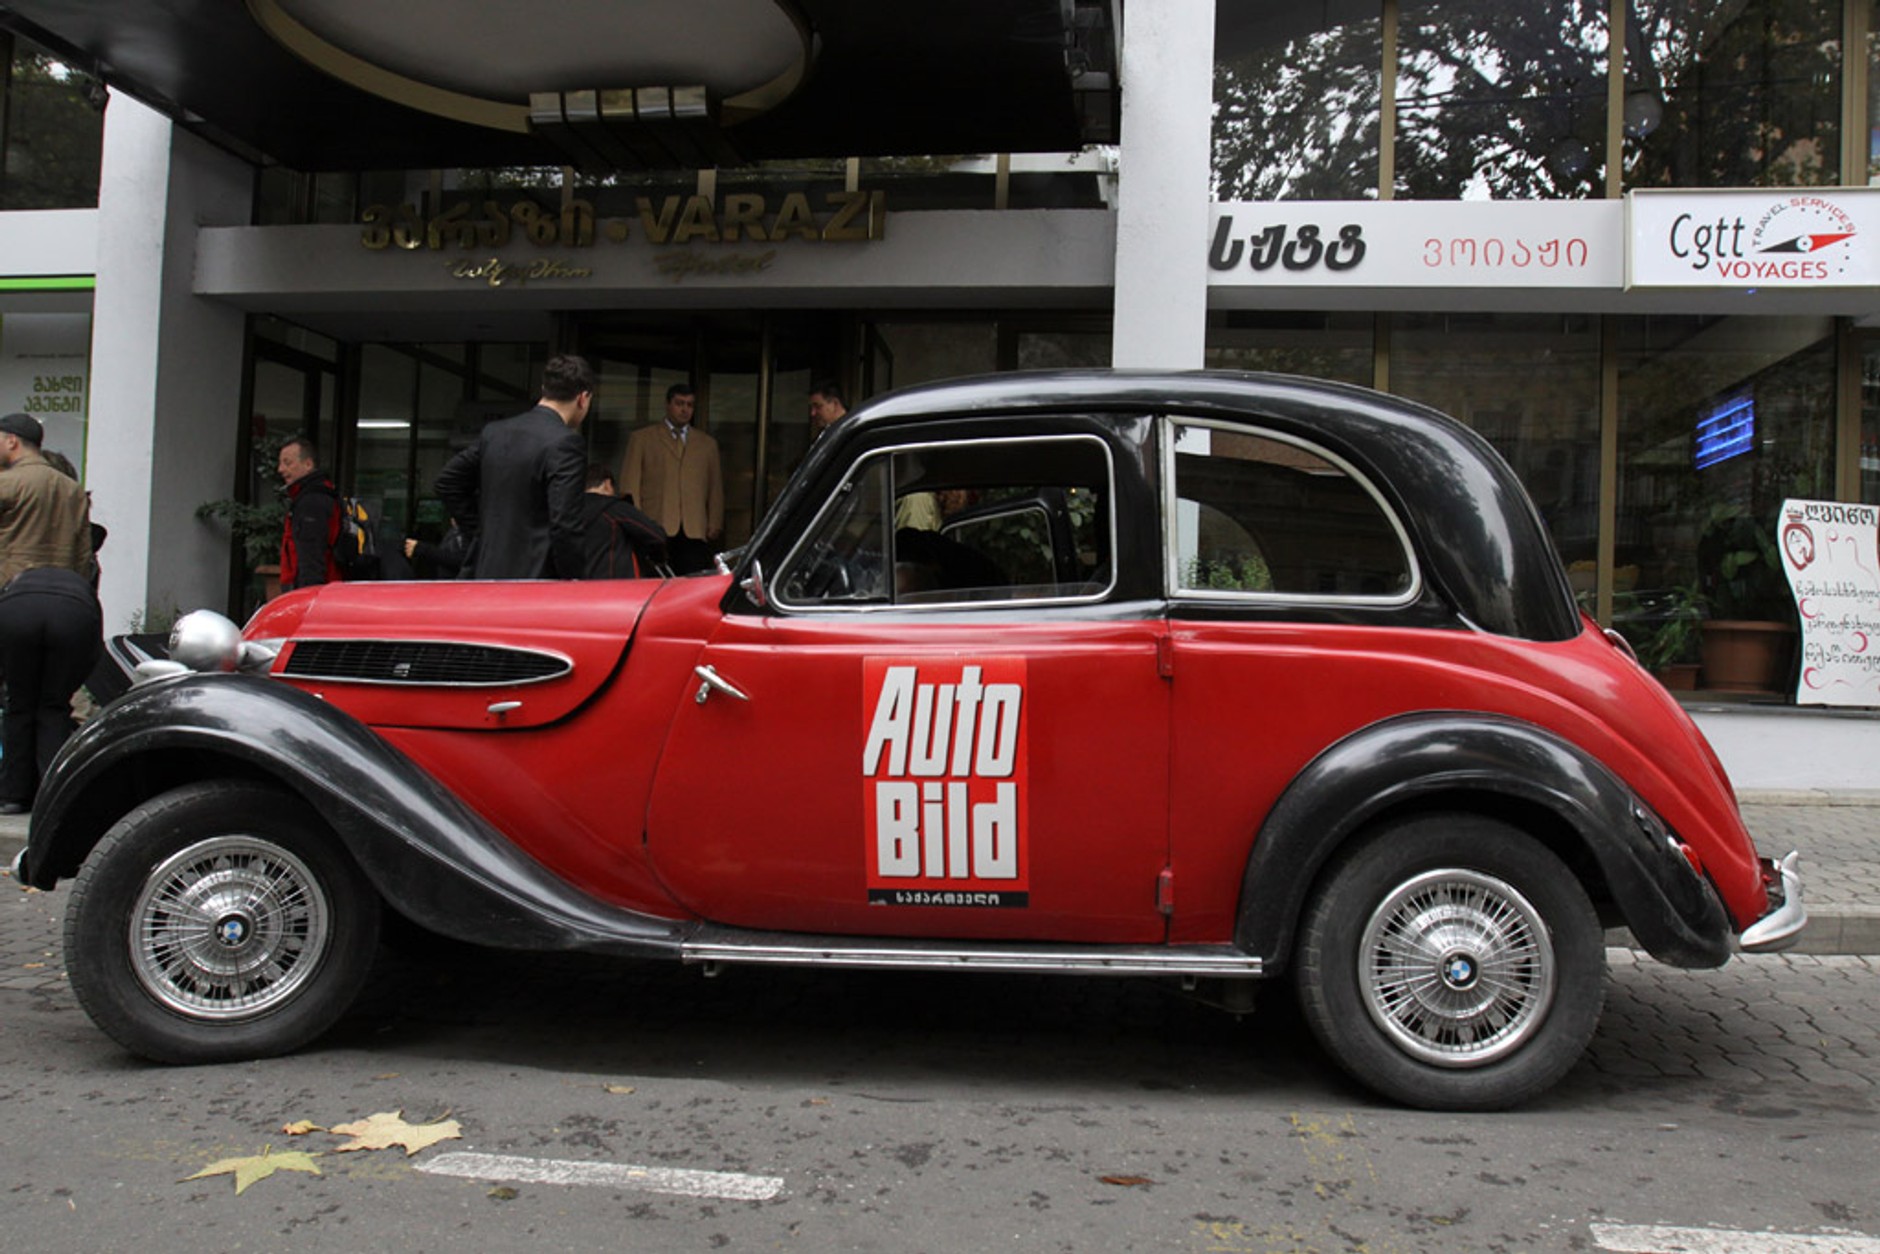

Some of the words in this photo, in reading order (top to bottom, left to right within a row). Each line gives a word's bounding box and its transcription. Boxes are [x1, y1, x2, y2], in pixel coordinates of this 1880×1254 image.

[361, 199, 596, 250] ვარაზი
[635, 190, 886, 244] VARAZI
[1208, 215, 1367, 271] სჟტტ
[1423, 238, 1588, 268] ვოიაჟი
[1670, 213, 1746, 270] Cgtt
[1752, 203, 1788, 247] TRAVEL
[1790, 196, 1856, 232] SERVICES
[1716, 261, 1829, 279] VOYAGES
[23, 395, 80, 412] აგენტი
[33, 376, 82, 392] გახდი
[863, 666, 1022, 777] Auto
[876, 781, 1017, 878] Bild
